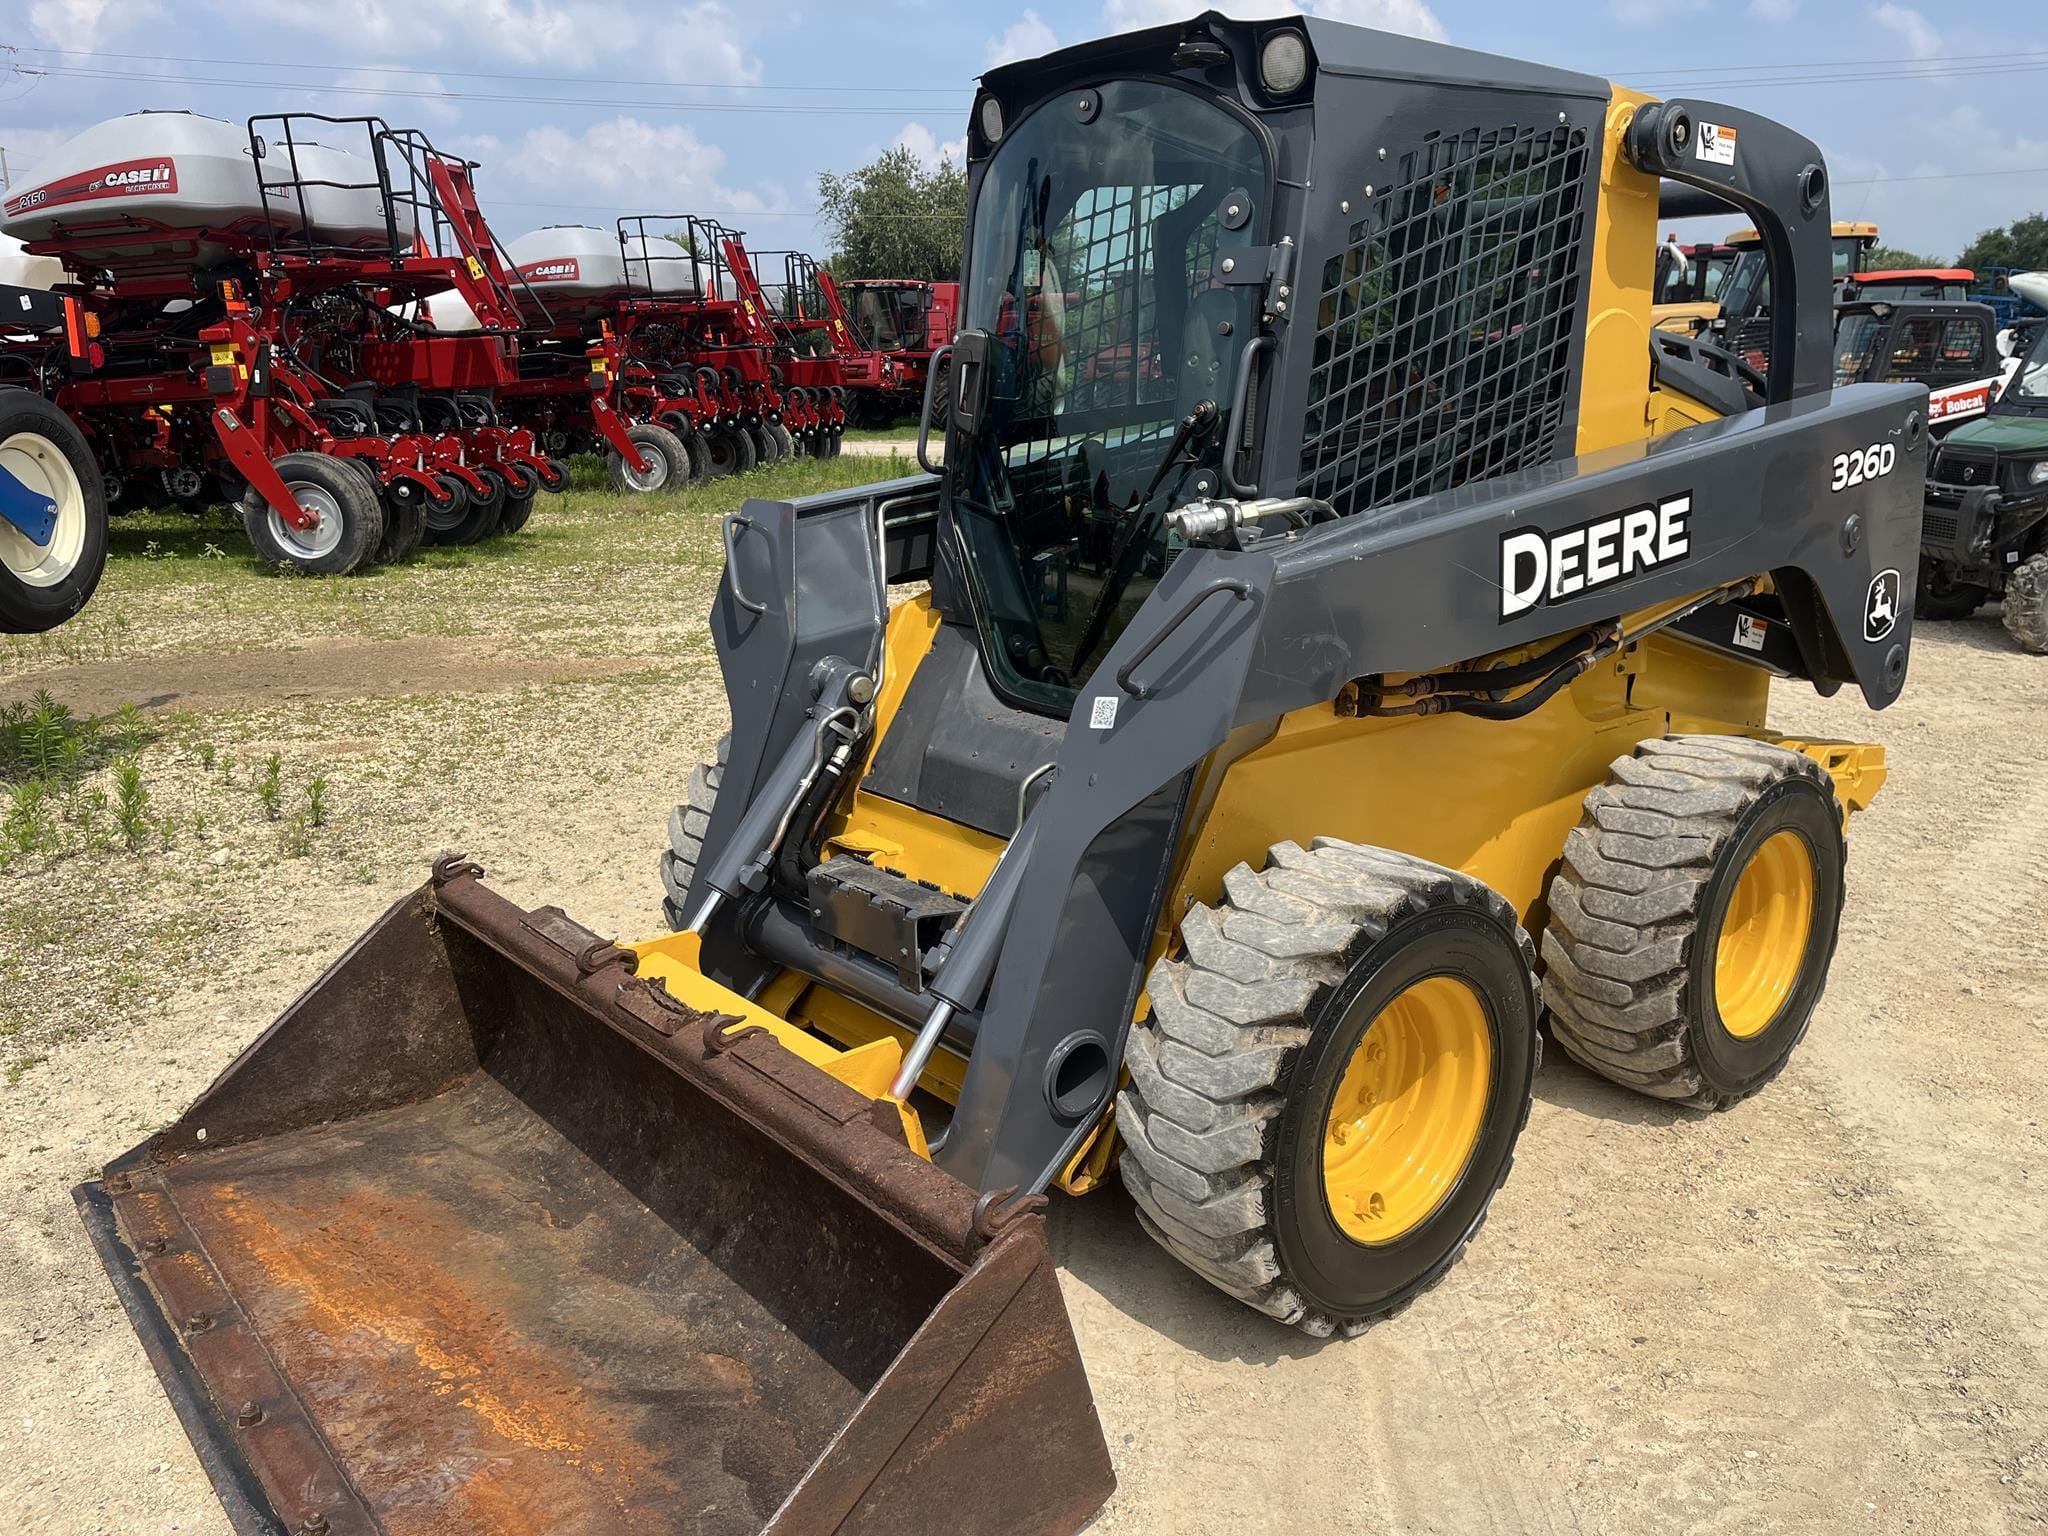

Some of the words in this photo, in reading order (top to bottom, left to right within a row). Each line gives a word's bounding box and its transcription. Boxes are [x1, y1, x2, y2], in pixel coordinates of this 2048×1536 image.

[105, 170, 151, 187] CASE
[20, 191, 46, 208] 2150
[535, 265, 563, 276] CASE
[1946, 394, 1983, 413] Bobcat
[1831, 443, 1896, 491] 326D
[1502, 497, 1690, 616] DEERE
